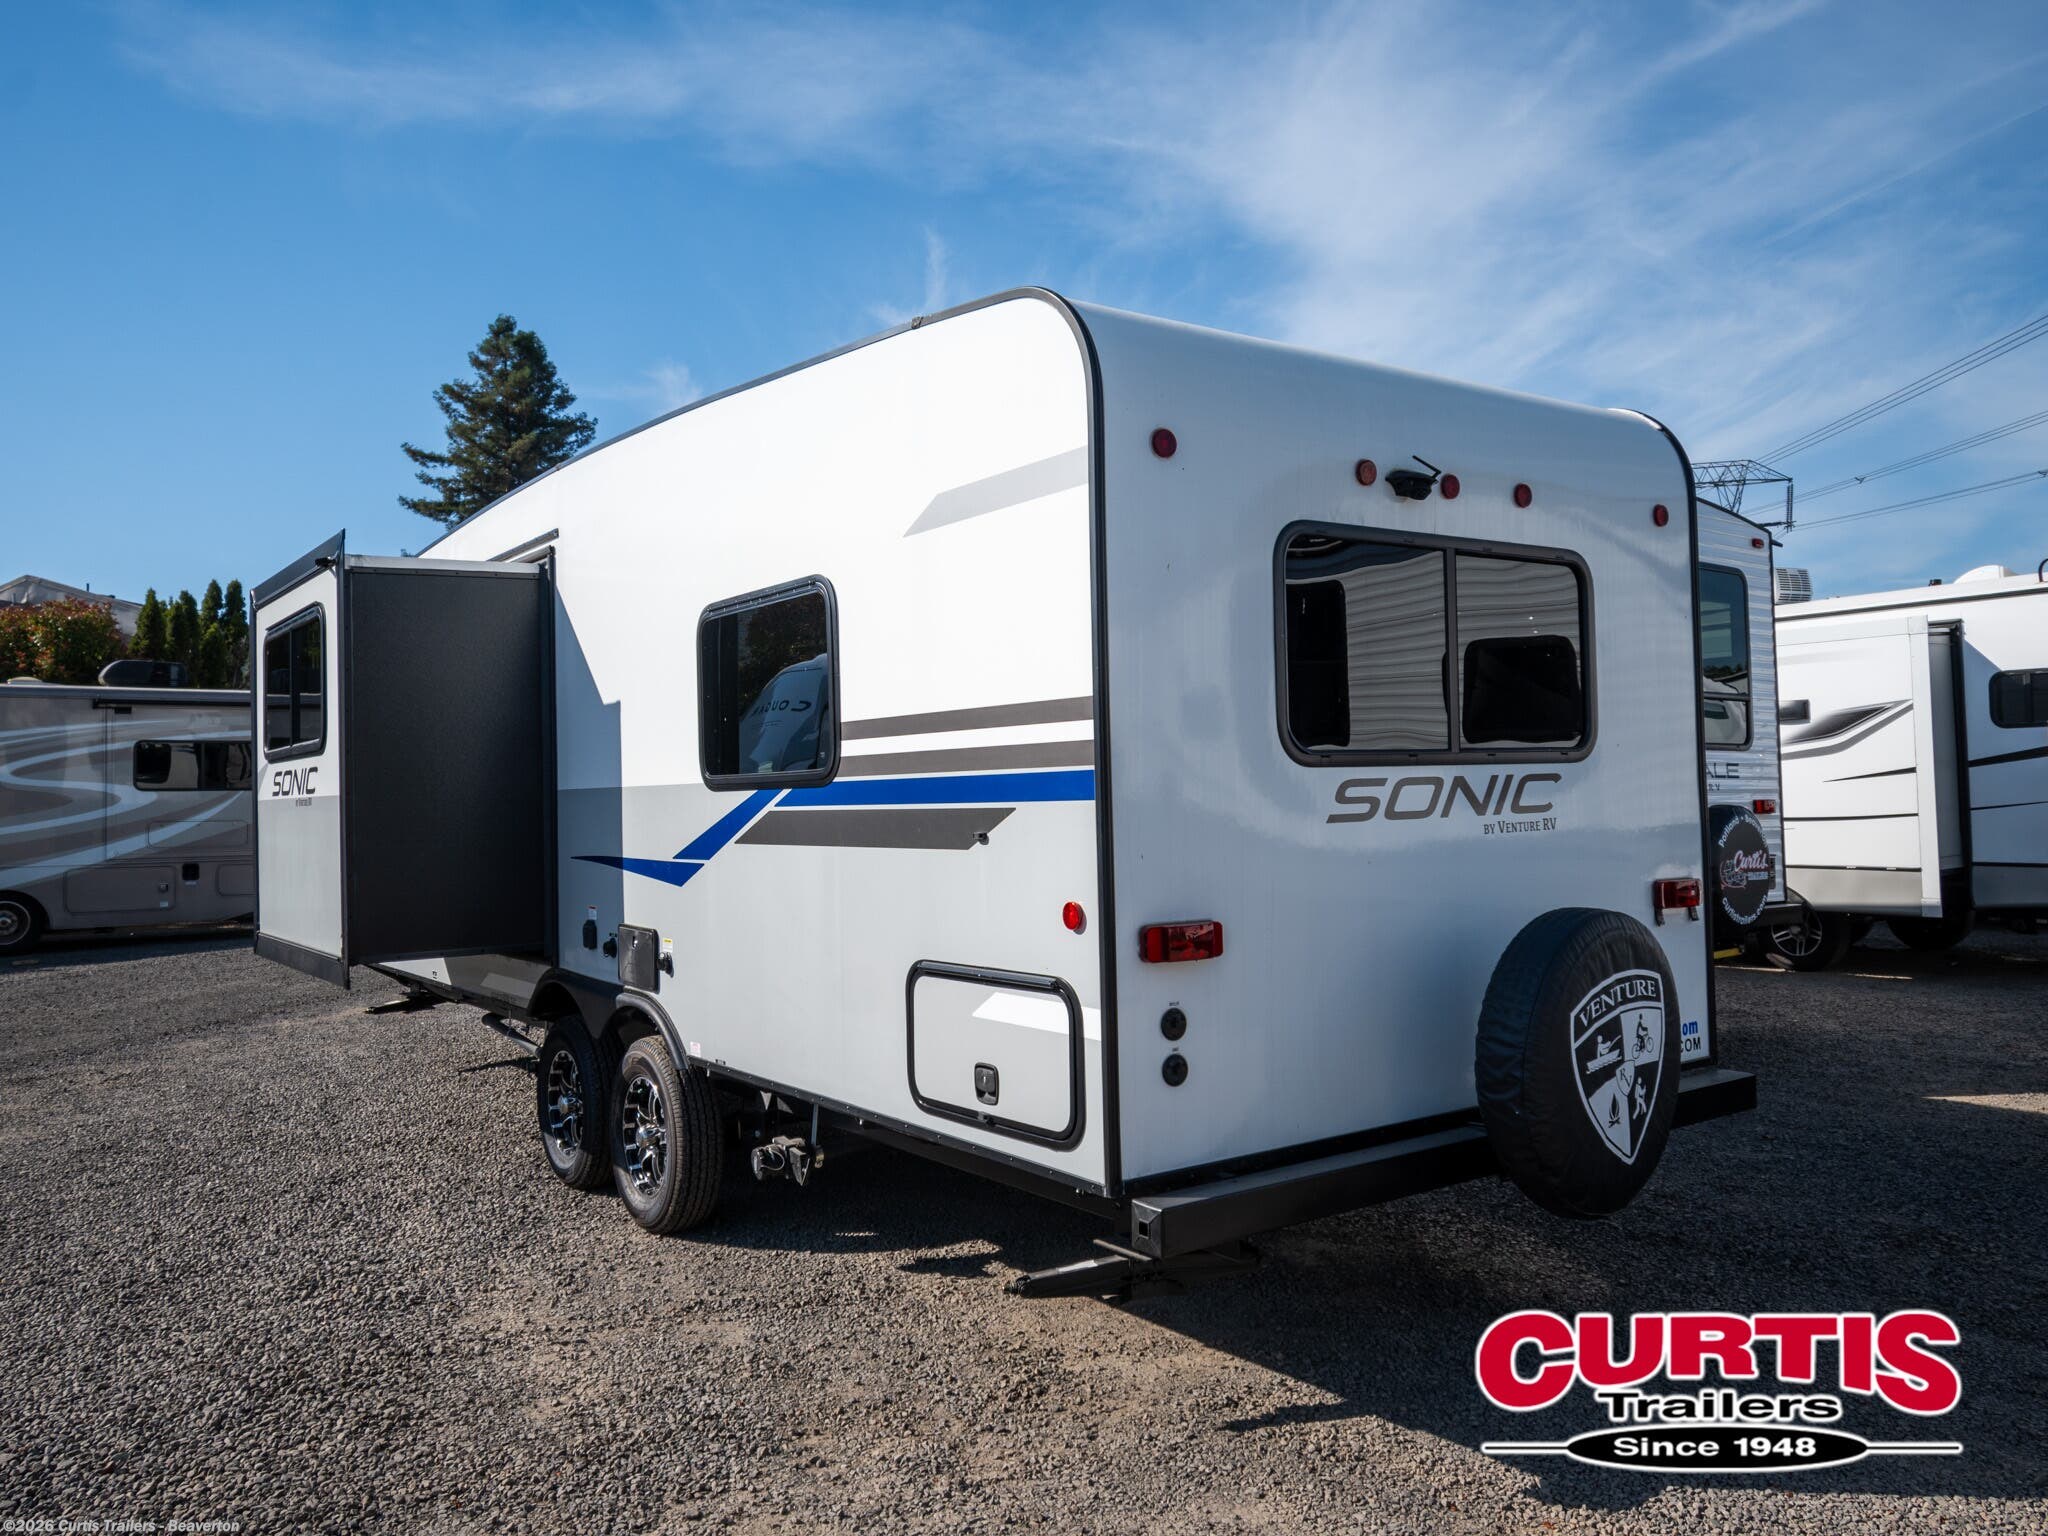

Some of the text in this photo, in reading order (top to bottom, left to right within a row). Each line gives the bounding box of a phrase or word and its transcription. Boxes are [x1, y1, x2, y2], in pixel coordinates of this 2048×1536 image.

[272, 766, 319, 797] SONIC
[1326, 773, 1562, 824] SONIC
[1483, 817, 1558, 835] BY VENTURE RV
[1733, 850, 1769, 873] Curtis
[1579, 979, 1657, 1028] VENTURE
